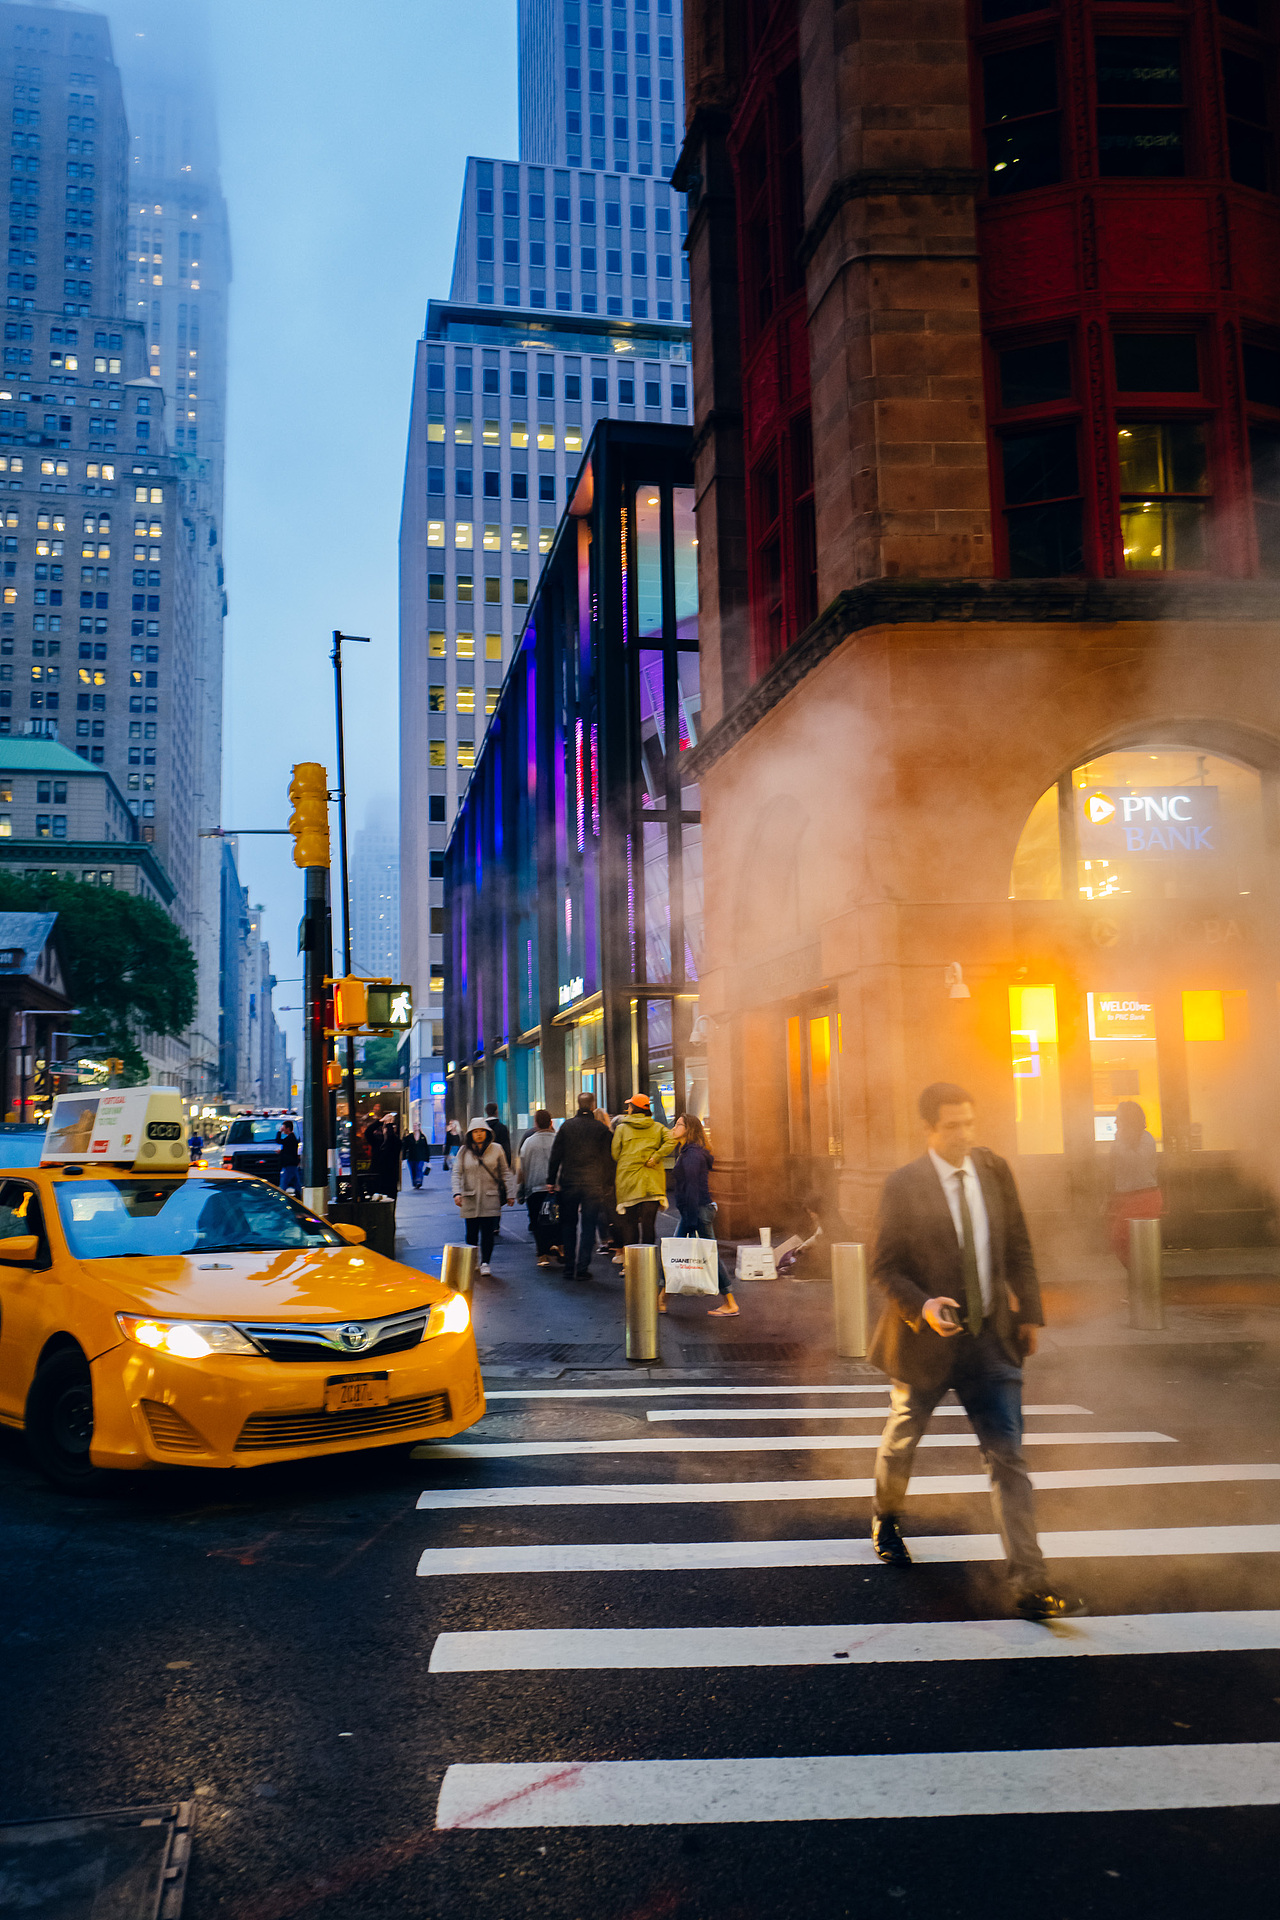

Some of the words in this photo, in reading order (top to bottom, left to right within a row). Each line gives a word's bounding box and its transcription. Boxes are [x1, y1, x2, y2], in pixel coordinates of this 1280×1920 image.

[1119, 795, 1193, 821] PNC
[1122, 826, 1215, 851] BANK
[1100, 1001, 1152, 1011] WELCOME
[150, 1124, 179, 1137] 2C87
